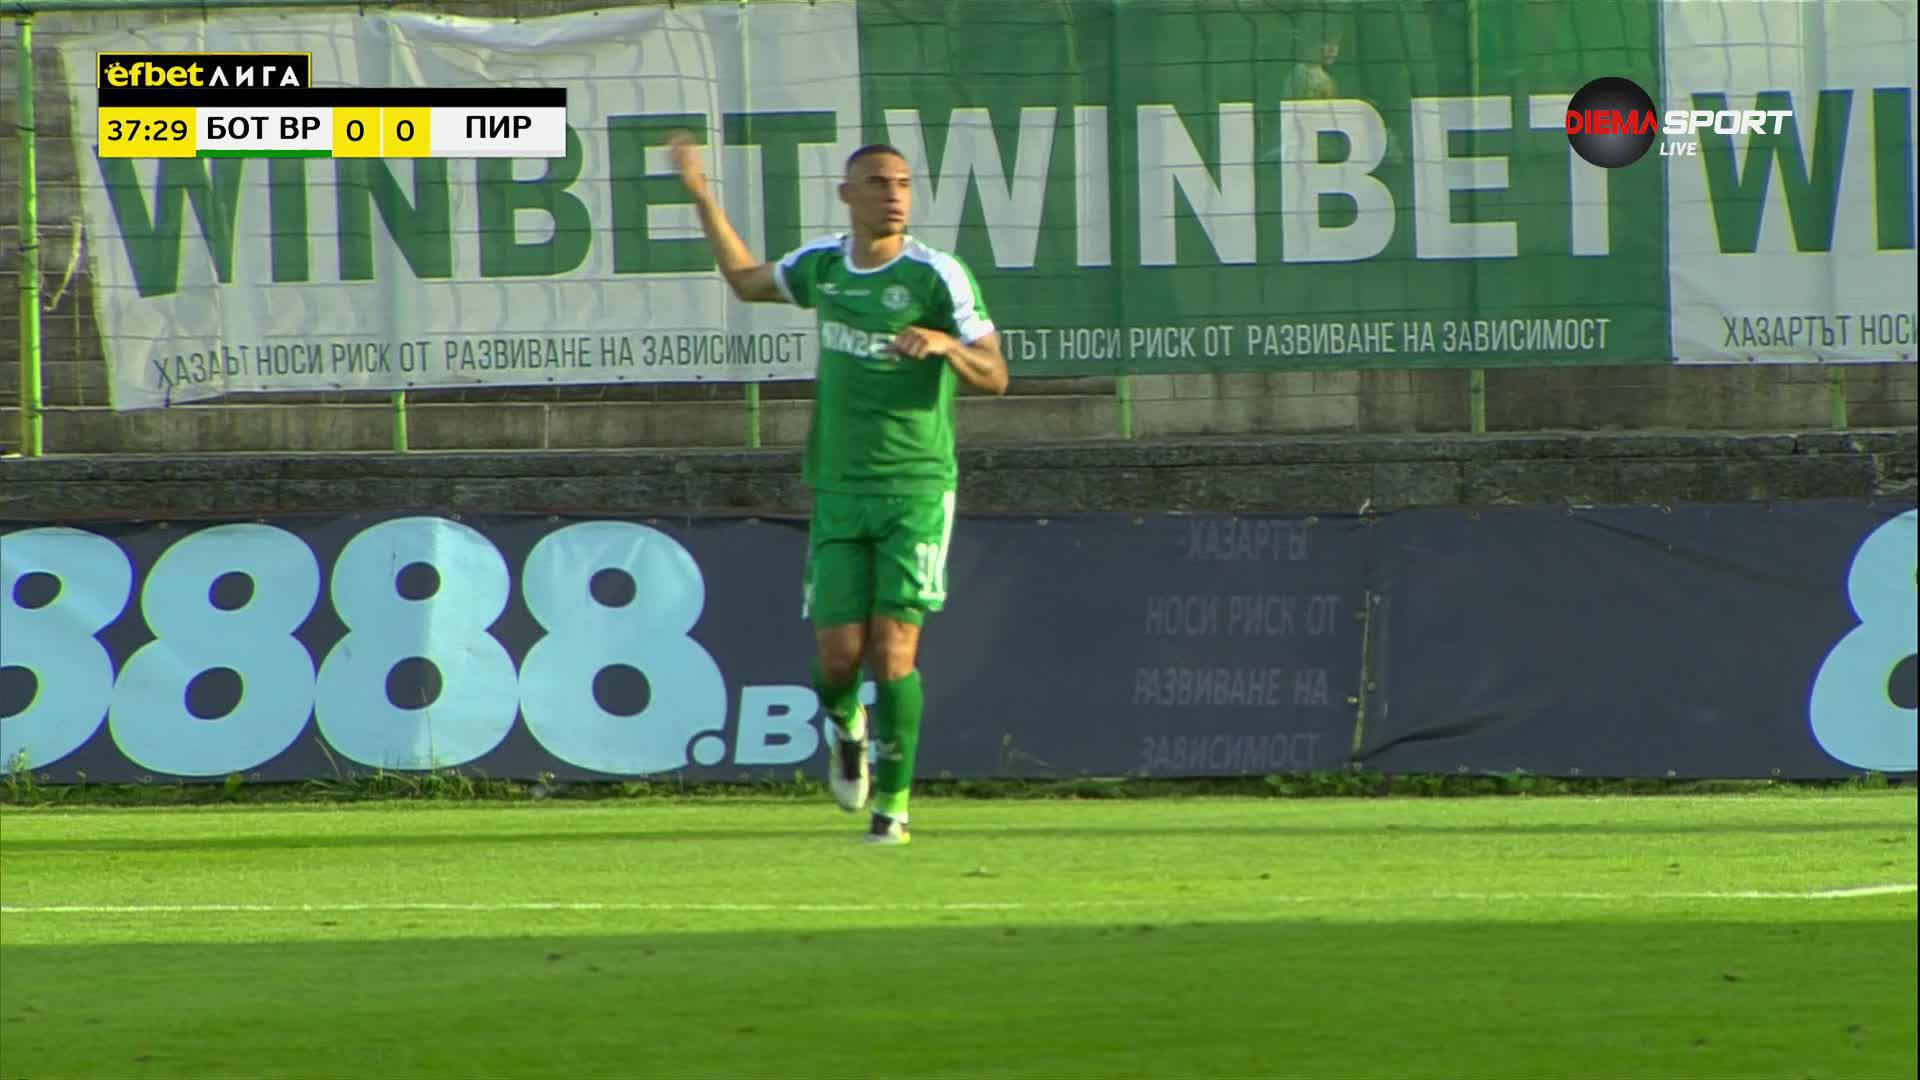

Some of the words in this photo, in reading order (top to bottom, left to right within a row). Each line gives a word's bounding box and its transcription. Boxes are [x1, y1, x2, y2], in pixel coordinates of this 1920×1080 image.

[884, 97, 1611, 267] WINBET
[93, 111, 837, 297] WINBET
[1060, 328, 1121, 359] НОСИ
[1130, 327, 1196, 358] РИСК
[1204, 325, 1235, 356] ОТ
[1248, 322, 1396, 355] РАЗВИВАНЕ
[1403, 321, 1435, 352] НА
[1443, 318, 1611, 352] ЗАВИСИМОСТ
[1722, 314, 1852, 347] ХАЗАРТЪТ
[256, 343, 323, 375] НОСИ
[331, 342, 390, 372] РИСК
[400, 340, 432, 372] ОТ
[445, 336, 592, 371] РАЗВИВАНЕ
[600, 335, 634, 367] НА
[642, 333, 806, 367] ЗАВИСИМОСТ
